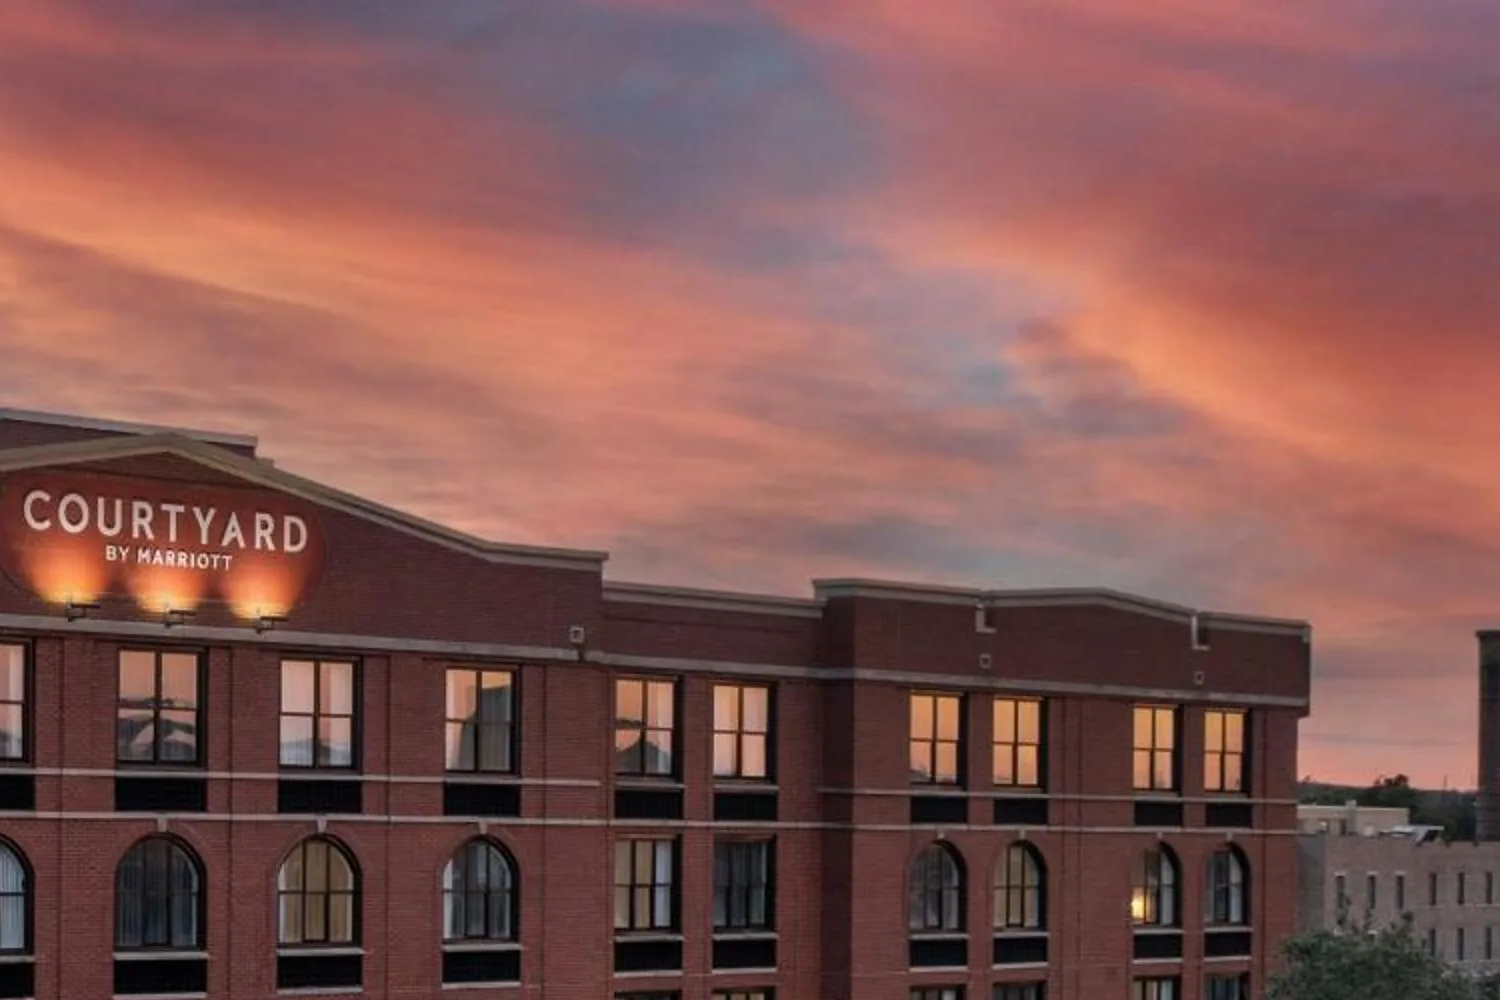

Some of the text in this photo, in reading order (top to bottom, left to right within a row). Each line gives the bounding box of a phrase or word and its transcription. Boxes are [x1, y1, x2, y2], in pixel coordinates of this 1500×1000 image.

[23, 490, 308, 552] COURTYARD
[106, 546, 233, 570] BY MARRIOTT
